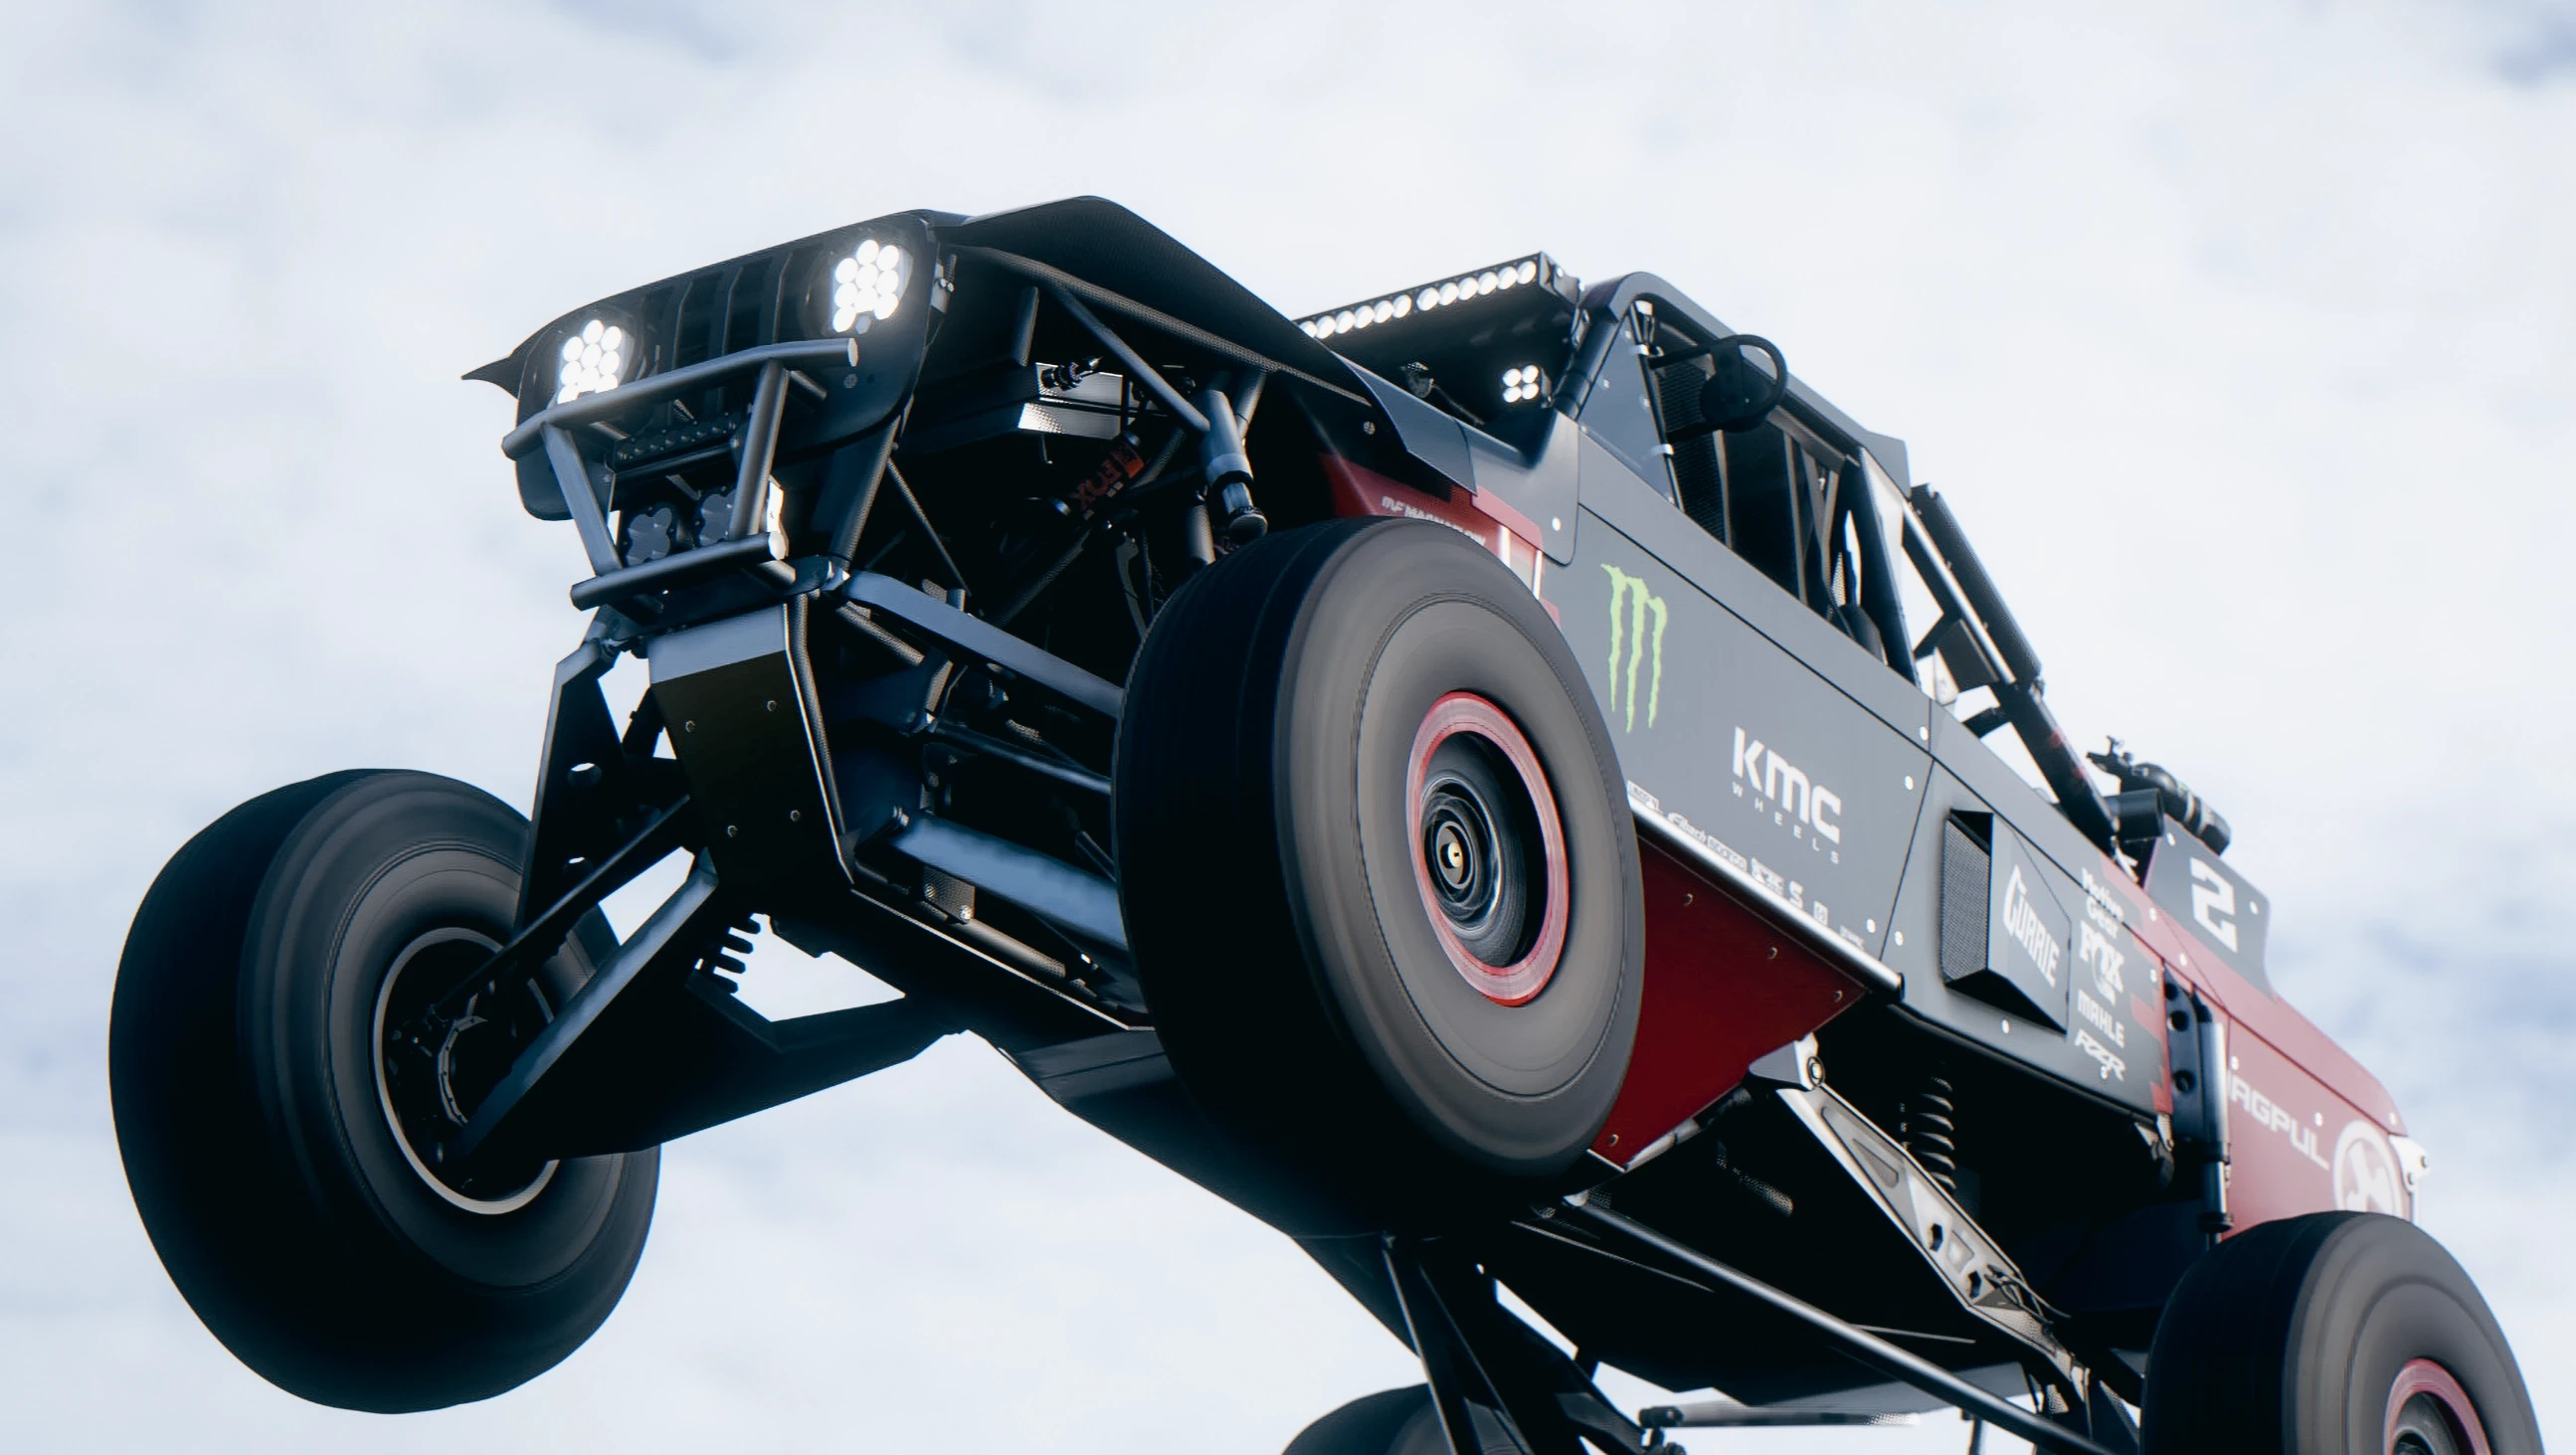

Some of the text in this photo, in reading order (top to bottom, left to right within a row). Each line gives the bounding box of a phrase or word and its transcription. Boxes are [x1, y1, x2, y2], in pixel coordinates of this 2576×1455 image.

[1404, 504, 1487, 547] MAGOW
[1732, 781, 1840, 864] WHEELS
[1733, 726, 1841, 844] KMC
[2191, 857, 2238, 953] 2
[2079, 919, 2125, 995] FOX
[2074, 1027, 2126, 1082] RZR
[2078, 989, 2125, 1049] MAHLE
[2226, 1068, 2329, 1171] AGPUL
